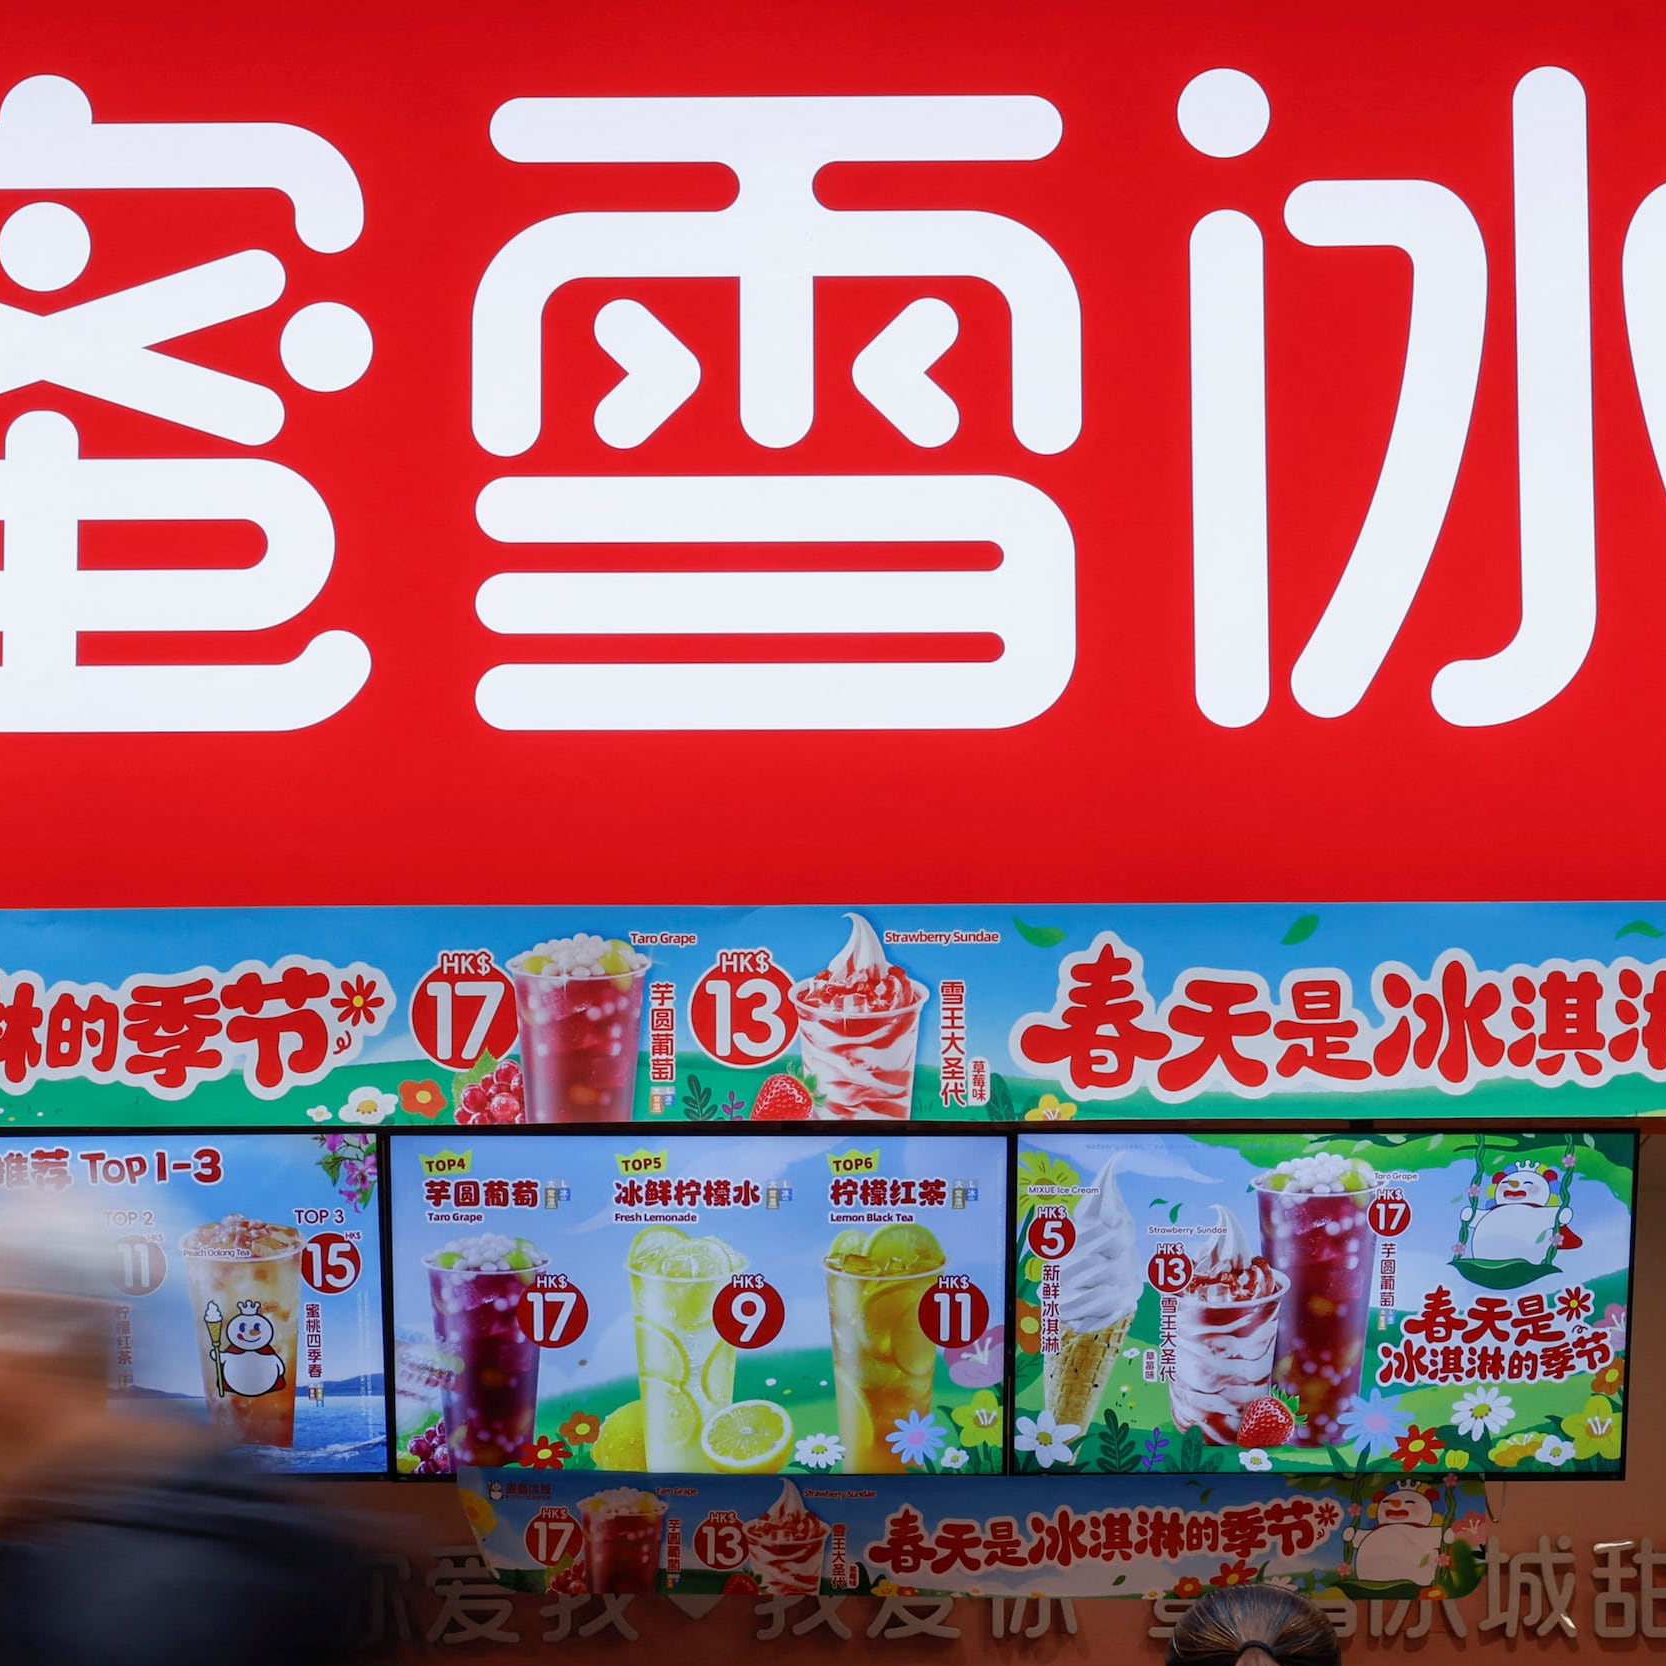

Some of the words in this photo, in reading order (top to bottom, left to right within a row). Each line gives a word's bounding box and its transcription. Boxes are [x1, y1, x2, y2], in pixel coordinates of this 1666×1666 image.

[631, 932, 658, 944] Taro
[660, 932, 697, 946] Grape
[885, 930, 951, 945] Strawberry
[953, 930, 1000, 943] Sundae
[440, 950, 493, 976] HK$
[720, 950, 770, 975] HK$
[425, 980, 506, 1061] 17
[651, 982, 675, 1081] 芋圆葡萄
[706, 978, 785, 1060] 13
[940, 980, 966, 1106] 雪王大圣代
[971, 1059, 988, 1103] 草莓味
[156, 1149, 222, 1184] 1-3
[425, 1158, 466, 1172] TOP4
[621, 1157, 662, 1171] TOP5
[832, 1157, 873, 1171] TOP6
[1374, 1172, 1391, 1180] Taro
[1392, 1172, 1418, 1182] Grape
[424, 1179, 539, 1208] 芋圆葡萄
[614, 1179, 761, 1207] 冰鲜柠檬水
[830, 1178, 947, 1206] 柠檬红茶
[1028, 1186, 1055, 1194] MIXUE
[1057, 1186, 1070, 1194] Ice
[1072, 1186, 1099, 1194] Cream
[1376, 1188, 1404, 1200] HK$
[104, 1212, 136, 1225] TOP
[143, 1211, 154, 1225] 2
[294, 1209, 330, 1224] TOP
[333, 1209, 345, 1223] 3
[427, 1212, 450, 1221] Taro
[452, 1212, 483, 1223] Grape
[615, 1213, 642, 1222] Fresh
[644, 1213, 697, 1222] Lemonade
[830, 1213, 865, 1222] Lemon
[867, 1213, 894, 1222] Black
[896, 1213, 913, 1222] Tea
[1037, 1206, 1067, 1219] HK$
[1375, 1203, 1406, 1231] 17
[344, 1232, 362, 1241] HK$
[1040, 1220, 1065, 1256] 5
[1148, 1226, 1194, 1236] Strawberry
[1196, 1226, 1228, 1235] Sundae
[208, 1249, 235, 1258] Oolong
[236, 1249, 250, 1257] Tea
[1156, 1242, 1184, 1255] HK$
[116, 1243, 151, 1288] 11
[306, 1242, 356, 1288] 15
[1154, 1257, 1187, 1286] 13
[1380, 1243, 1396, 1307] 芋圆葡萄
[536, 1275, 569, 1289] HK$
[732, 1275, 766, 1289] HK$
[937, 1275, 970, 1289] HK$
[526, 1292, 578, 1343] 17
[729, 1292, 769, 1343] 9
[933, 1293, 973, 1343] 11
[1042, 1265, 1061, 1353] 新鲜冰淇淋
[1403, 1285, 1566, 1347] 春天是
[305, 1303, 323, 1378] 蜜桃四季春
[1160, 1297, 1178, 1382] 雪王大圣代
[1379, 1331, 1612, 1383] 冰淇淋的季节
[675, 1488, 699, 1497] Grape
[541, 1507, 568, 1519] HK$
[709, 1511, 737, 1524] HK$
[533, 1522, 575, 1562] 17
[666, 1518, 681, 1573] 芋圆葡萄
[704, 1526, 744, 1566] 13
[868, 1499, 1316, 1574] 春天是冰淇淋的季节
[831, 1524, 847, 1590] 雪王大圣代
